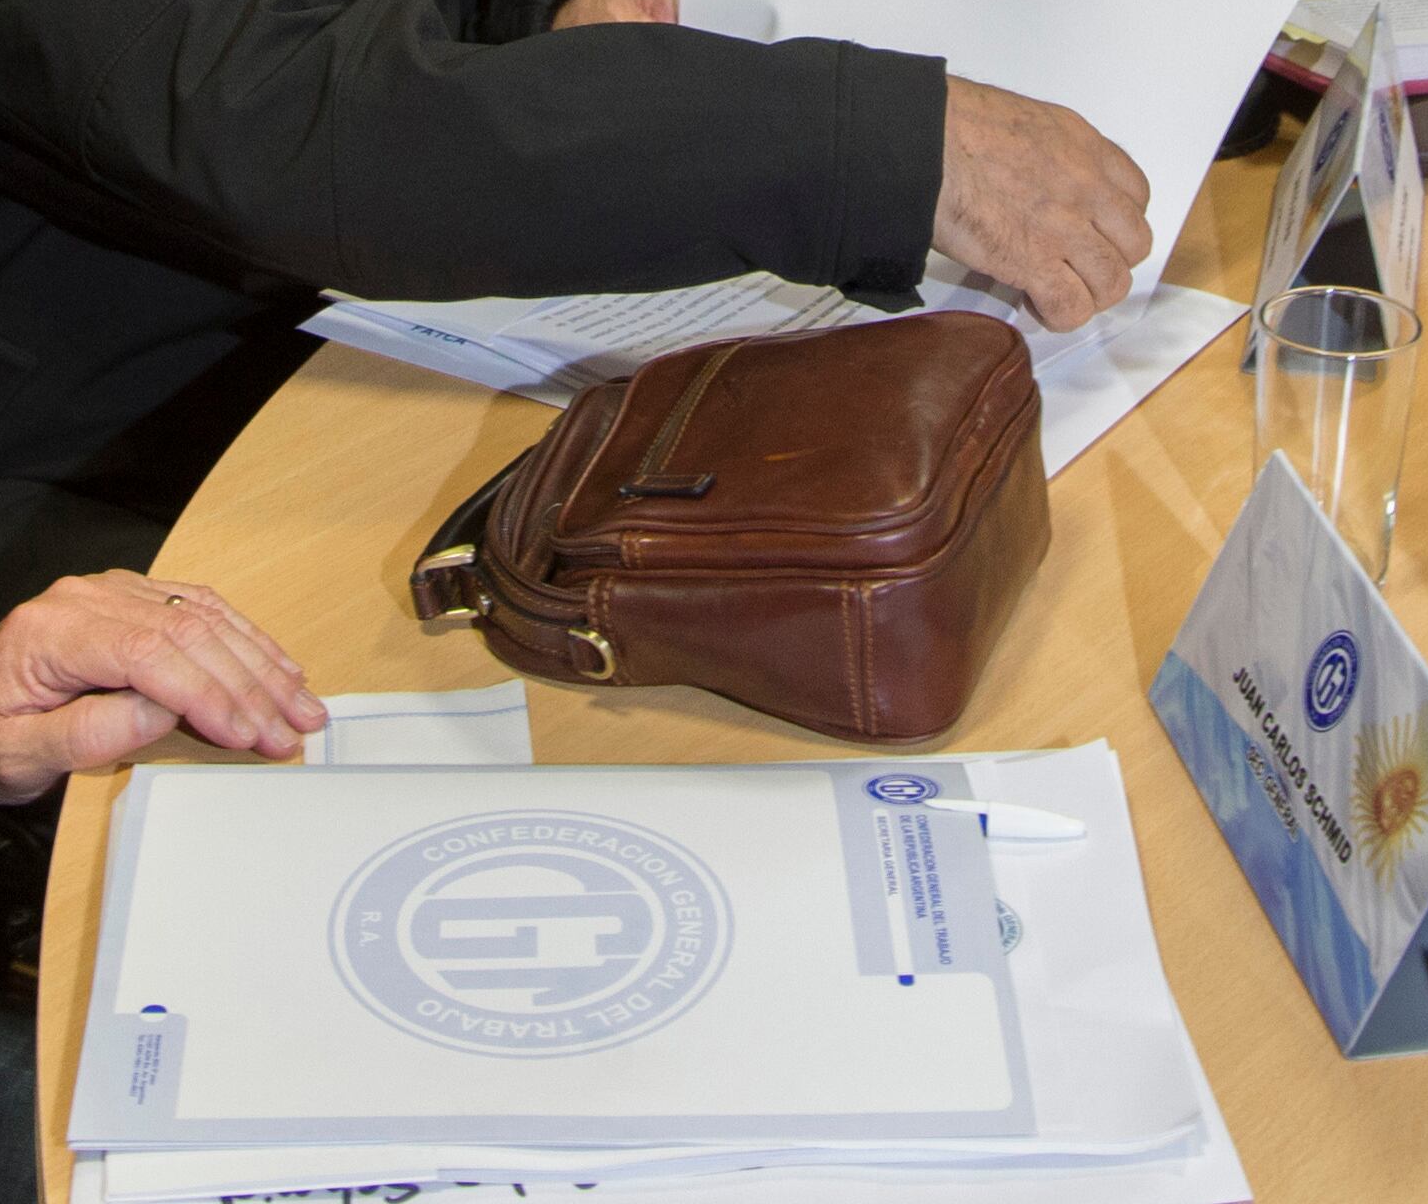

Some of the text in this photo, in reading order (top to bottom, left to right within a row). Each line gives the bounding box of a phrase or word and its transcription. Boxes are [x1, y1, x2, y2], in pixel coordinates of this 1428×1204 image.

[1233, 667, 1352, 864] JUAN CARLOS SCHMID
[910, 875, 927, 919] ARGENTINA
[926, 873, 942, 909] GENERAL
[416, 824, 704, 1039] CONFEDERACION GENERAL DEL TRABAJO
[932, 910, 946, 925] DEL
[934, 928, 952, 965] TRABAJO
